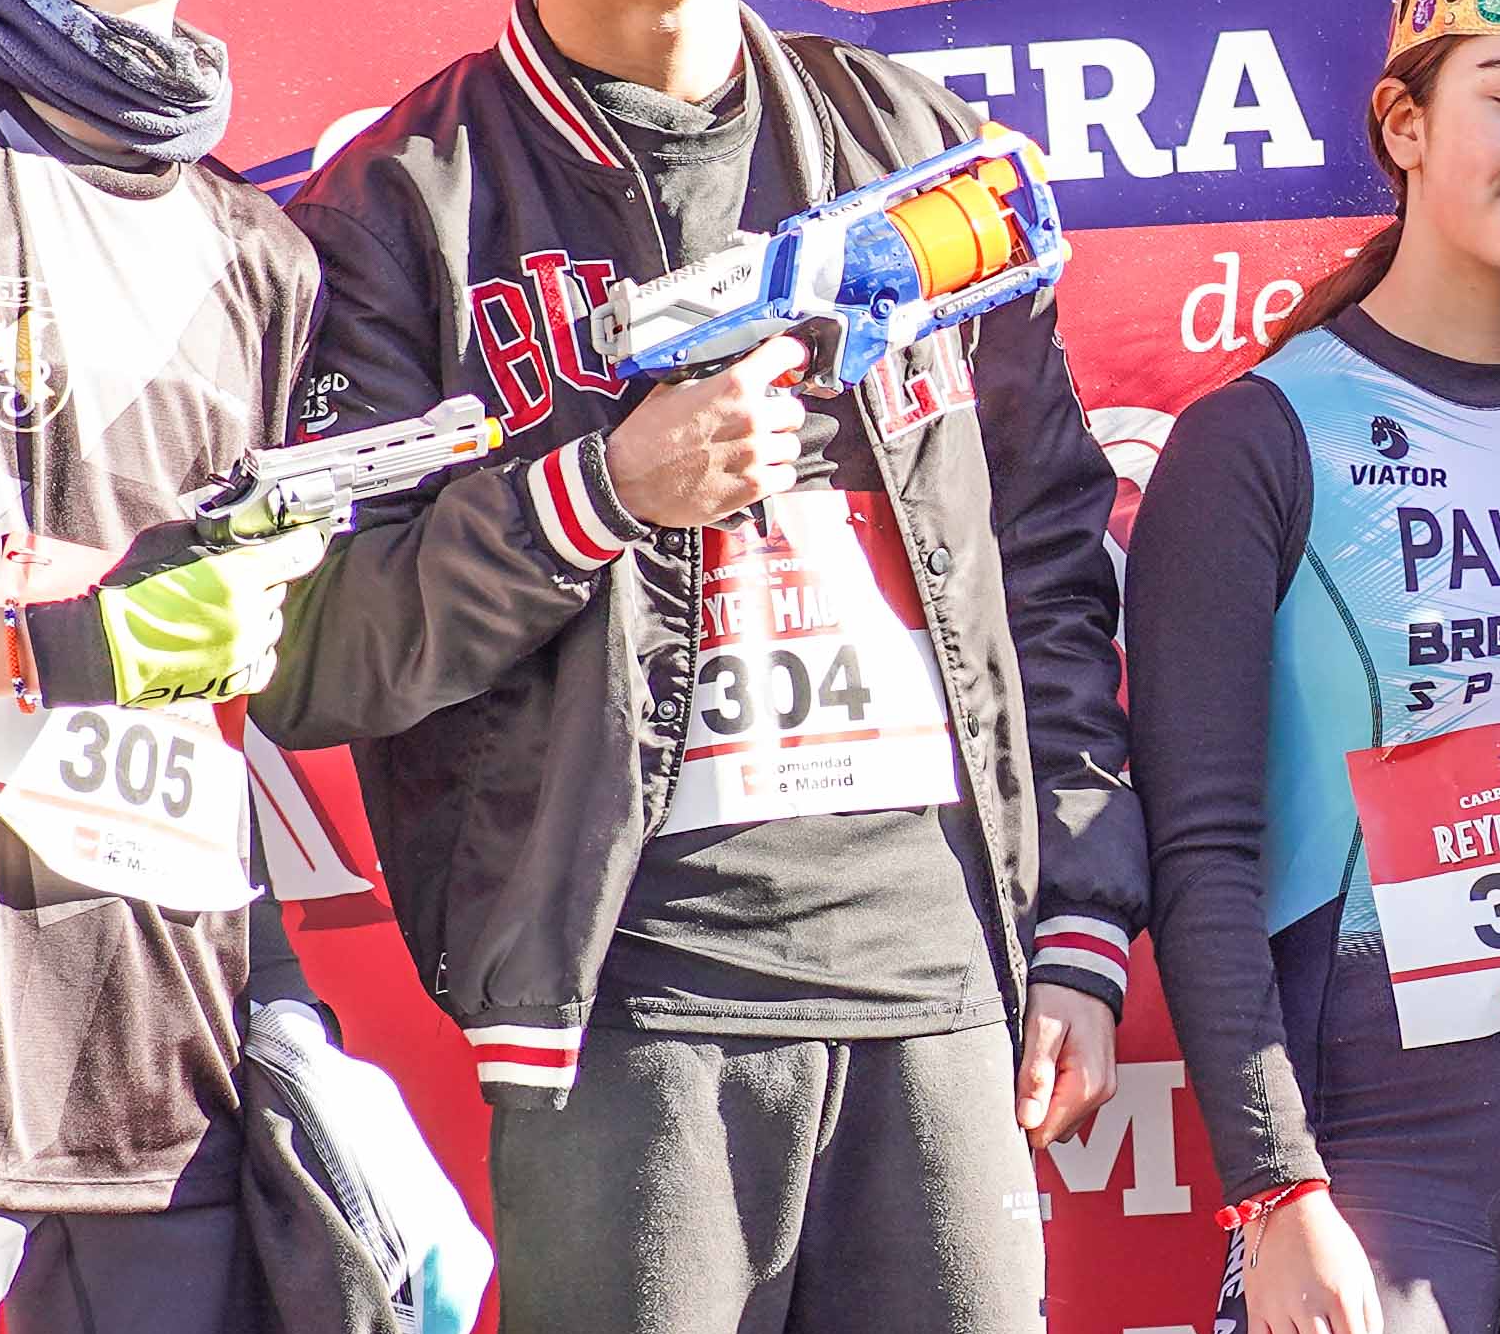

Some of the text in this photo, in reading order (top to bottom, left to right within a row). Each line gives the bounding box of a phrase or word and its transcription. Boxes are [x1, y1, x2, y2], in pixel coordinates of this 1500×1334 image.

[1181, 251, 1304, 353] de
[1350, 464, 1447, 487] VIATOR
[699, 644, 871, 735] 304
[60, 711, 194, 818] 305
[777, 755, 852, 773] omunidad
[796, 773, 854, 792] Madrid
